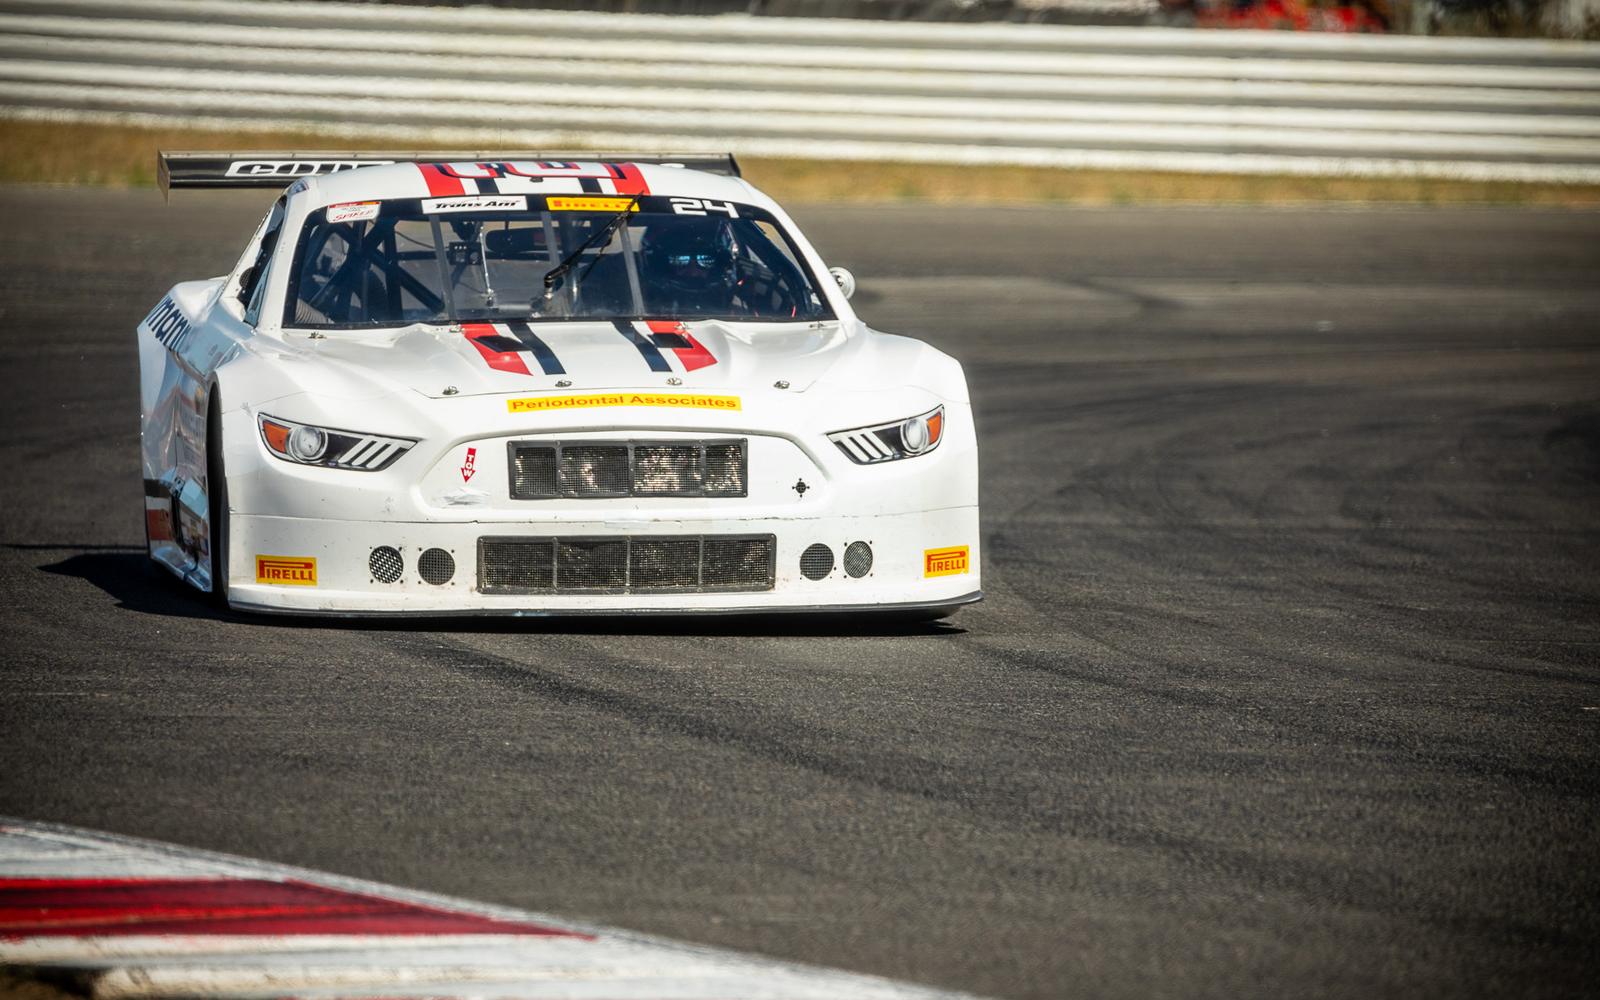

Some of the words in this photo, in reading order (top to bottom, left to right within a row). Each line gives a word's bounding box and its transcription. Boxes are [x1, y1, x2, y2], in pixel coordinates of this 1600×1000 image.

[435, 201, 482, 209] Trans
[484, 200, 518, 208] Am
[552, 199, 634, 208] PIRELL
[669, 198, 740, 218] 24
[512, 395, 624, 410] Periodontal
[630, 395, 736, 408] Associates
[464, 454, 475, 477] TOW
[258, 559, 313, 581] PIRELLI
[926, 550, 966, 573] PIRELLI
